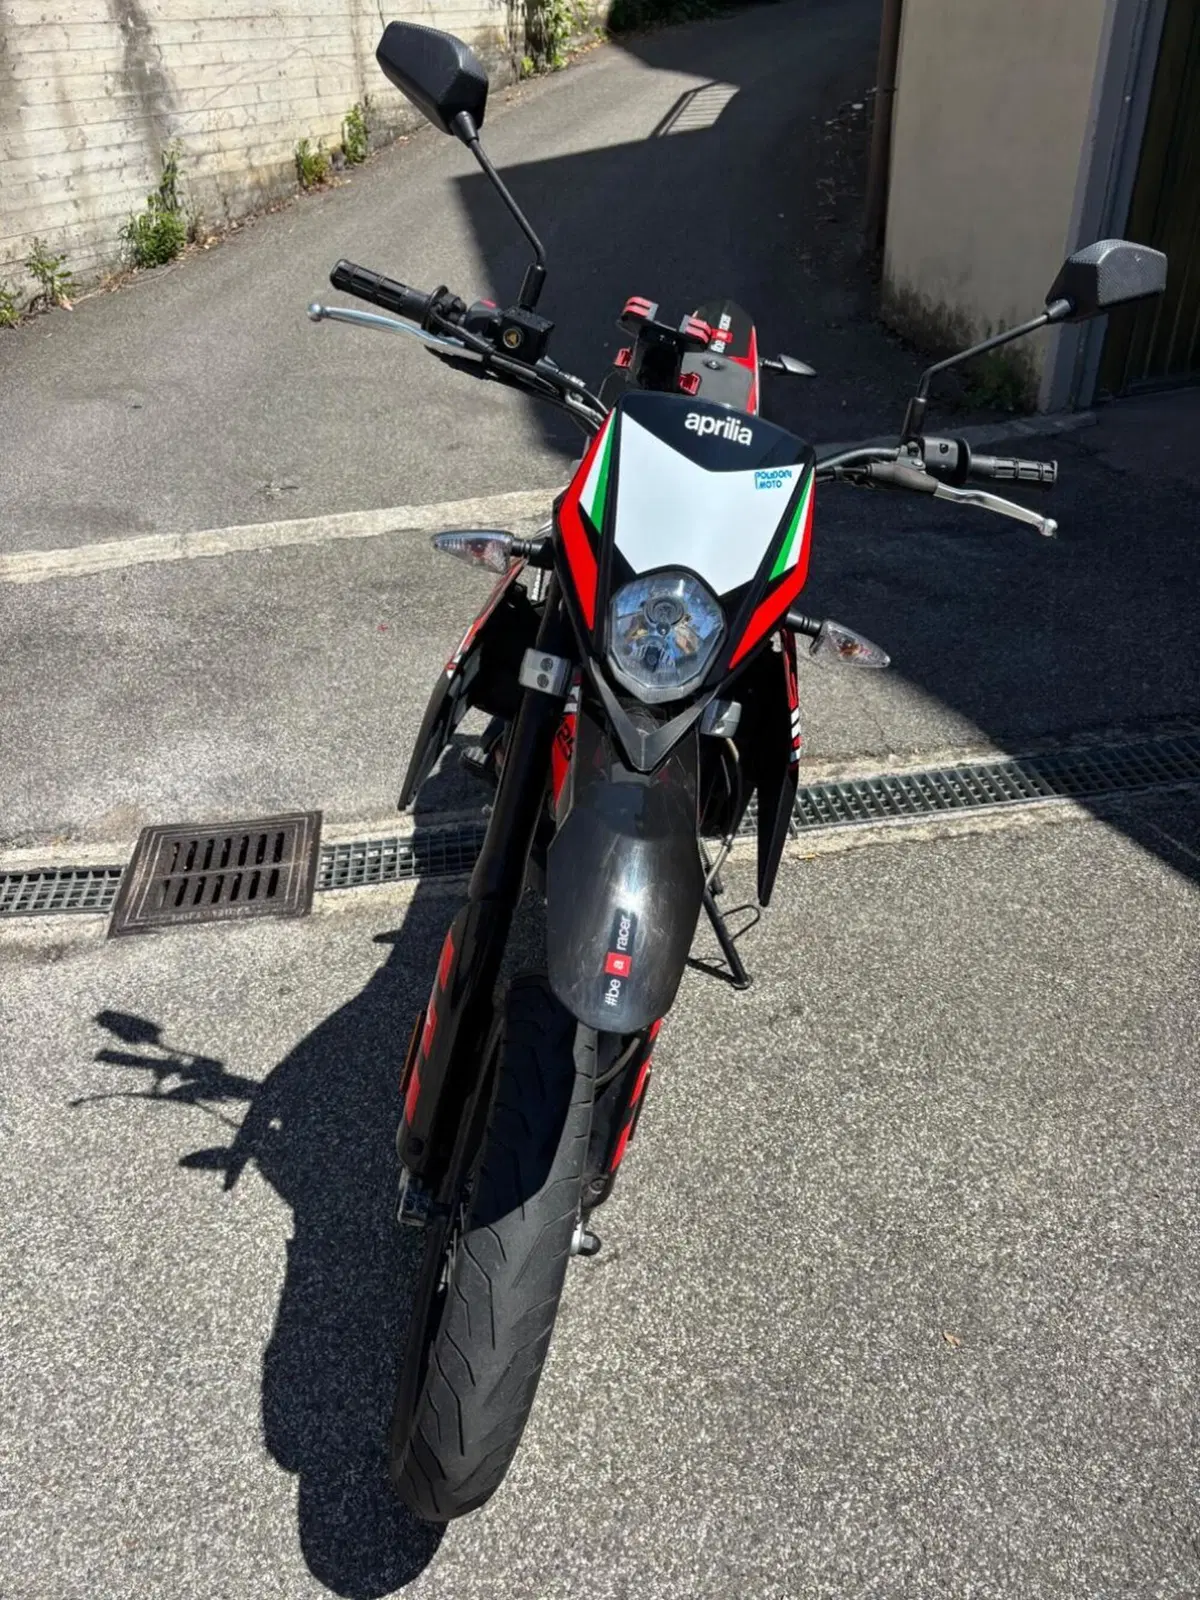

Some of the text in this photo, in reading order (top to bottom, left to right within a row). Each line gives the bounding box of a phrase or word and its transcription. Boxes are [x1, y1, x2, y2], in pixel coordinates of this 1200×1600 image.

[684, 412, 753, 445] aprilia
[759, 480, 783, 489] MOTO
[604, 915, 632, 1006] #be a racer
